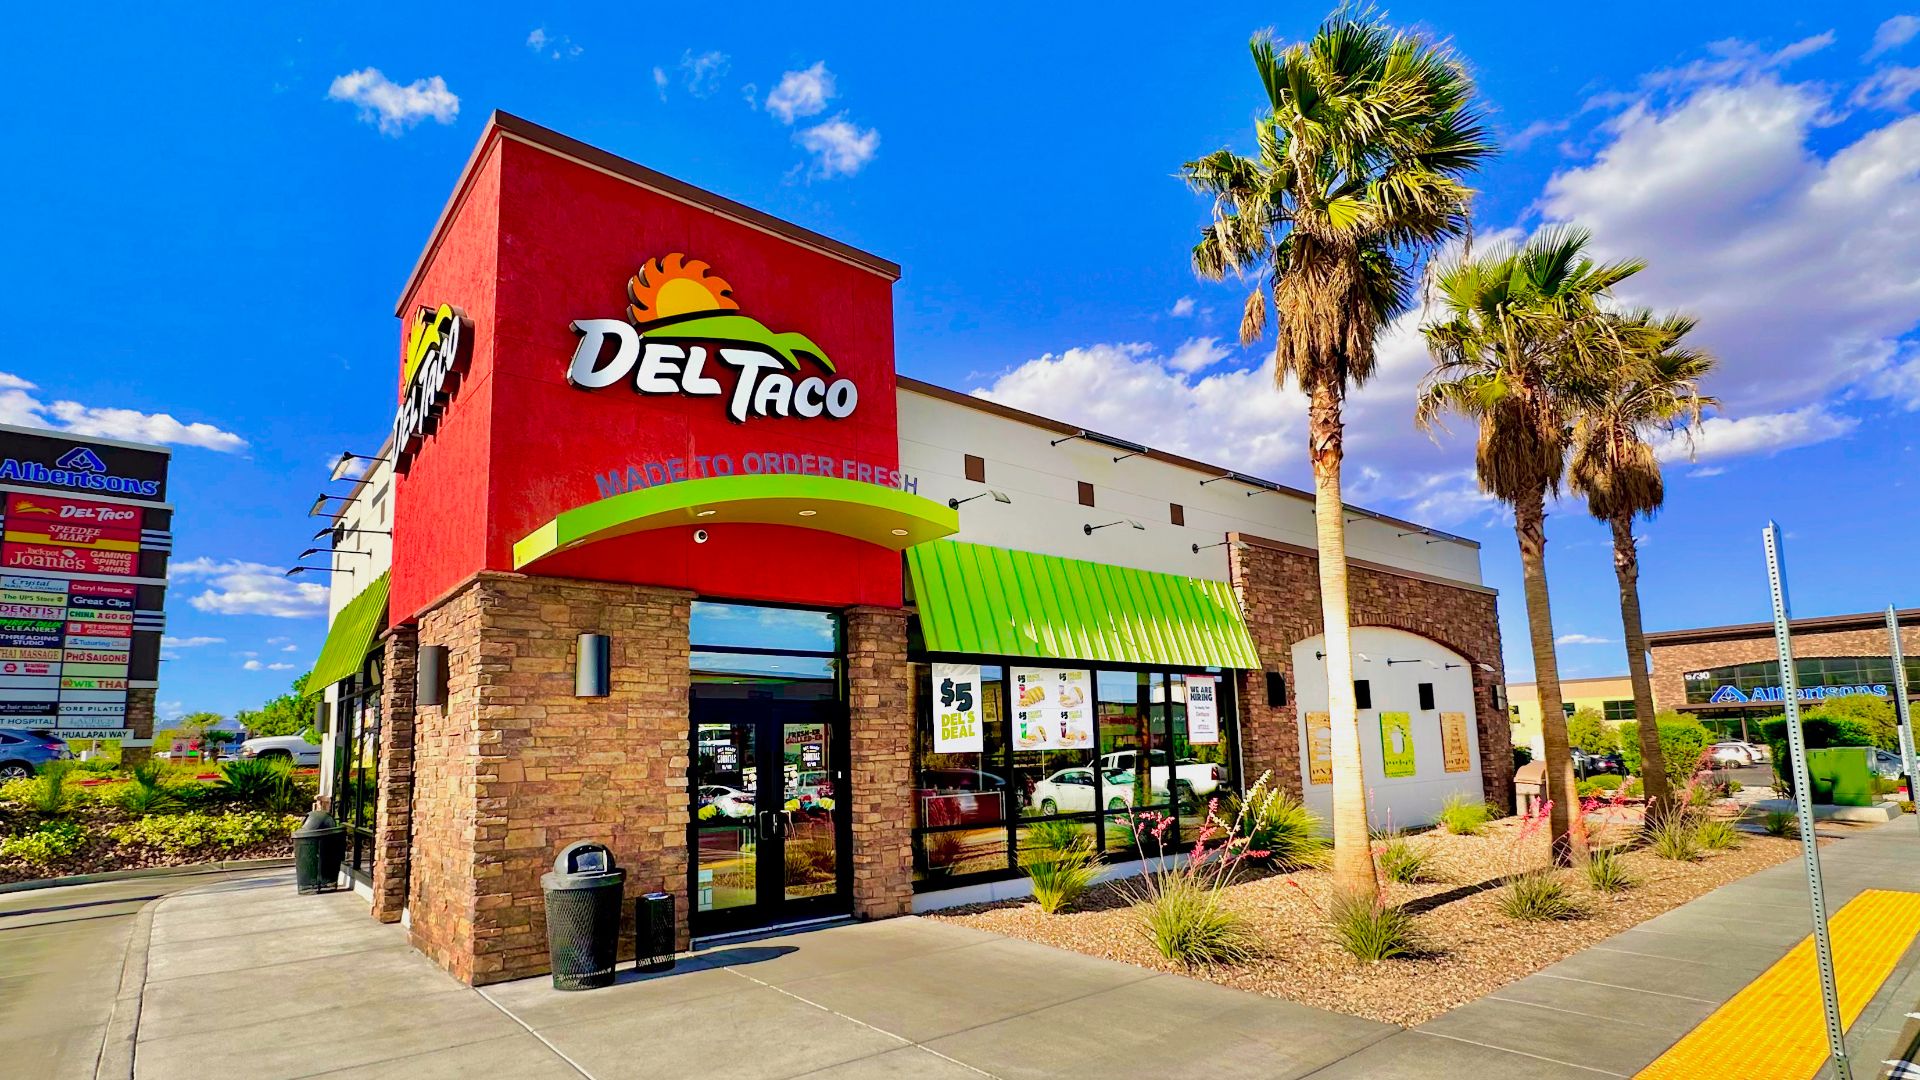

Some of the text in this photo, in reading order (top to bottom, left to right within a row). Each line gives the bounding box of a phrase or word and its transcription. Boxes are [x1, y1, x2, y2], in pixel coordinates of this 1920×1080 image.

[567, 319, 858, 423] DEL TACO
[0, 458, 157, 496] Albertsons
[594, 452, 918, 499] MADE TO ORDER FRESH
[60, 505, 135, 522] DEL TACO
[48, 524, 102, 537] SPEEDEE
[55, 533, 94, 543] MART
[90, 550, 132, 560] GAMING
[9, 551, 86, 570] Joanie's
[92, 558, 131, 567] SPIRITS
[98, 565, 131, 574] 24HRS
[72, 596, 131, 608] Great Clips
[0, 605, 64, 616] DENTIST
[69, 610, 96, 619] CHINA
[4, 625, 57, 633] CLEANERS
[0, 634, 60, 642] THREADING
[79, 639, 111, 648] Tutoring
[19, 649, 59, 660] MASSAGE
[1018, 675, 1026, 683] $5
[1059, 673, 1067, 681] $5
[940, 677, 974, 712] $5
[1190, 686, 1212, 694] WE ARE
[1190, 693, 1213, 701] HIRING
[941, 709, 976, 727] DEL'S
[1019, 711, 1027, 720] $5
[1060, 711, 1069, 720] $5
[62, 731, 107, 739] HUALAPAI
[109, 731, 128, 739] WAY
[941, 723, 976, 741] DEAL
